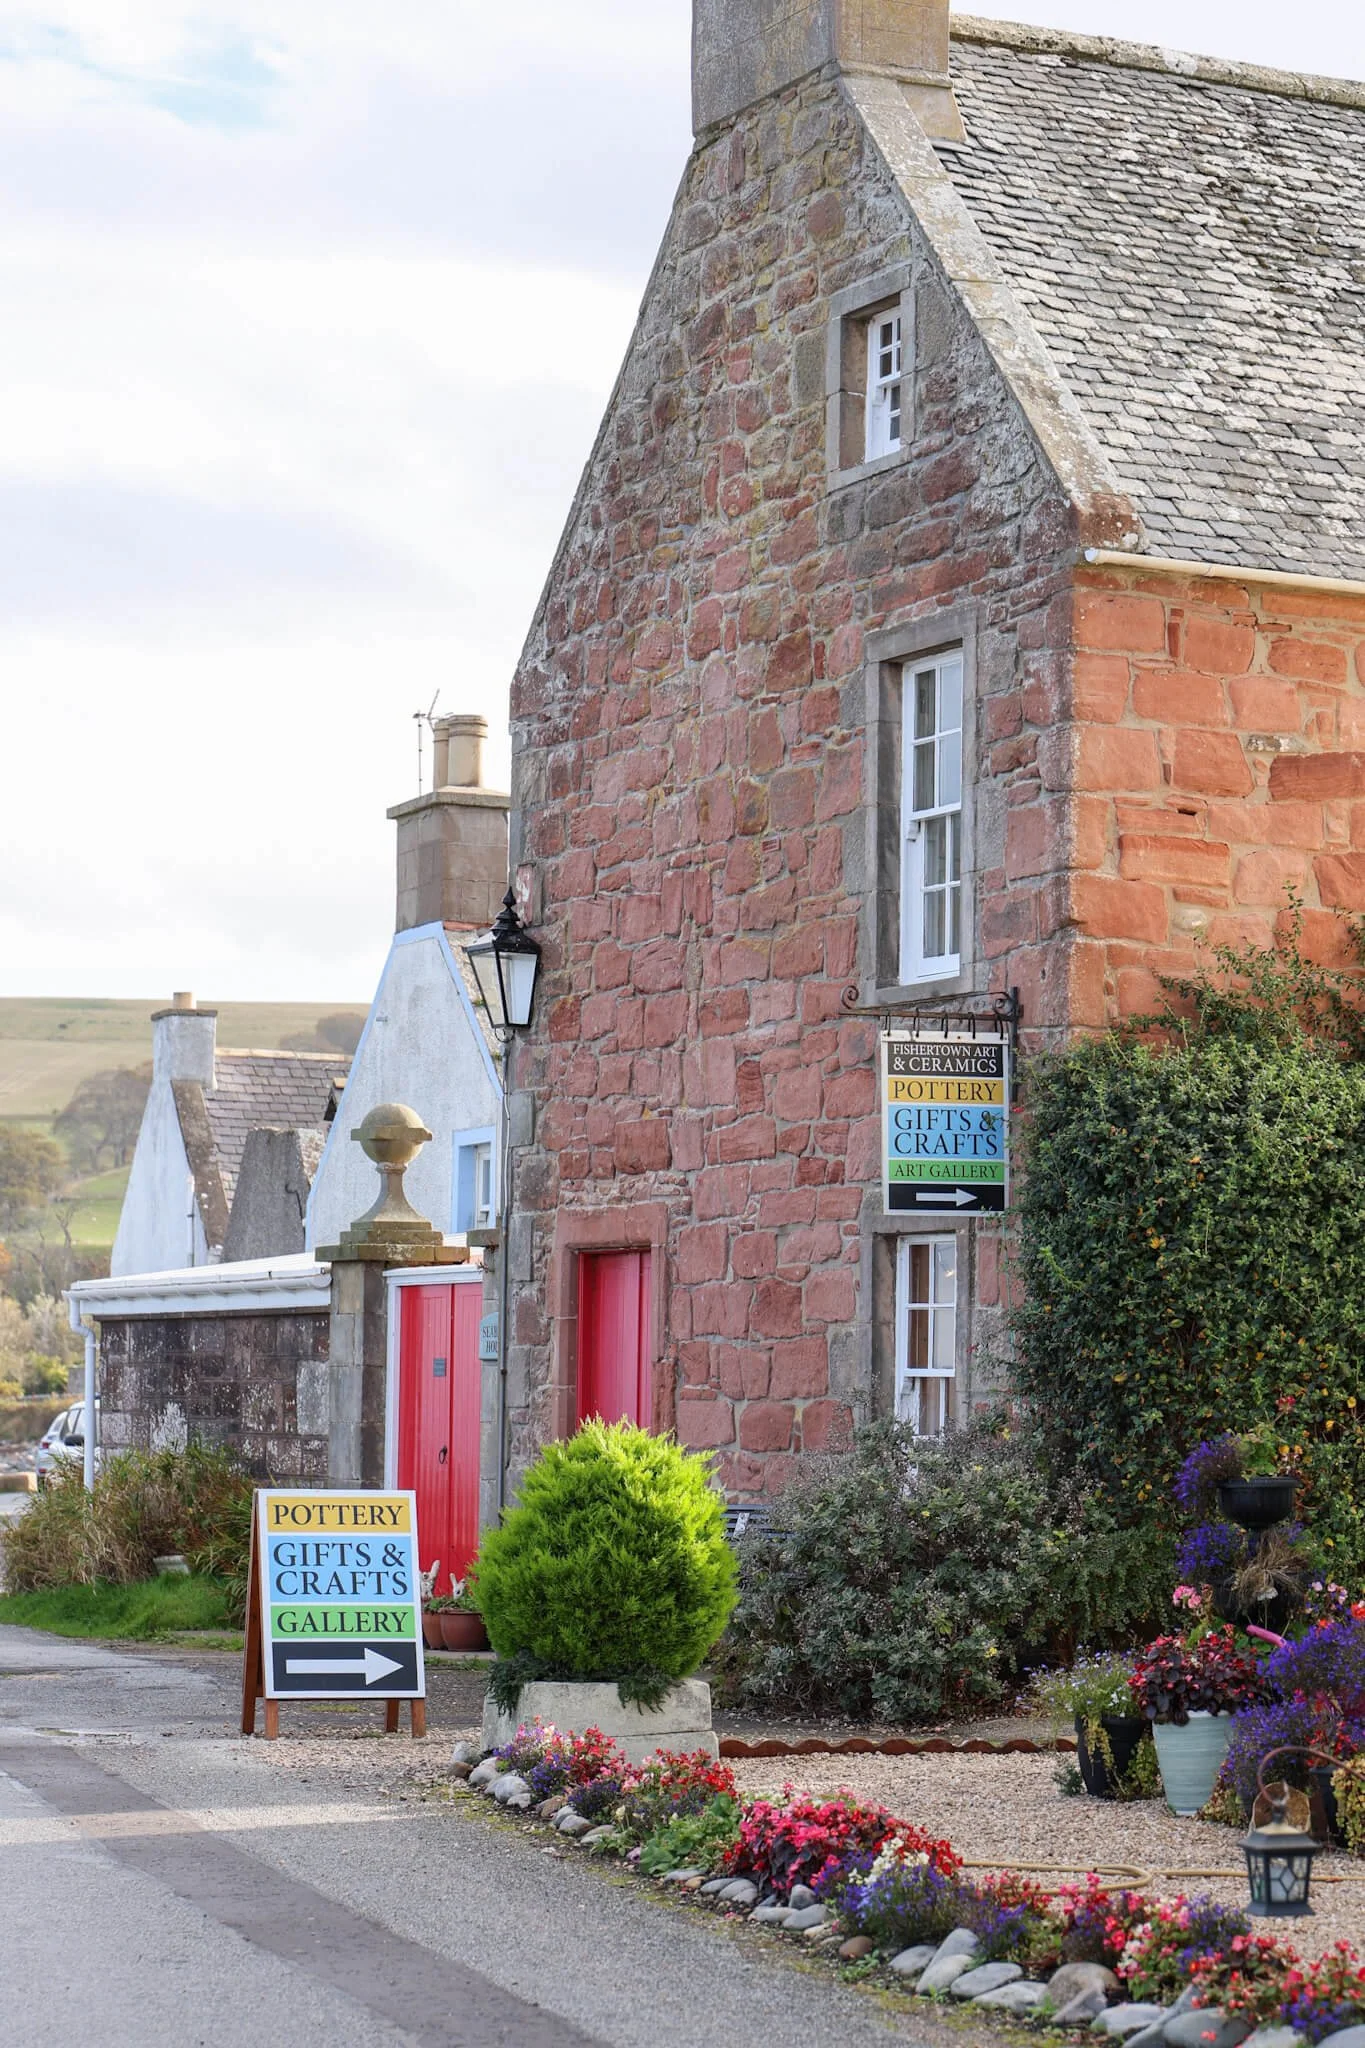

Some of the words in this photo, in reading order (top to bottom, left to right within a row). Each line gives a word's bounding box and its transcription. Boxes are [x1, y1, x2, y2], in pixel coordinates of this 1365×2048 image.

[893, 1043, 971, 1057] FISHERTOWN
[974, 1046, 998, 1058] ART
[893, 1056, 905, 1071] &
[908, 1057, 997, 1073] CERAMICS
[893, 1080, 998, 1101] POTTERY
[894, 1108, 971, 1132] GIFTS
[979, 1110, 998, 1132] &
[894, 1132, 998, 1156] CRAFTS
[894, 1163, 926, 1177] ART
[929, 1164, 999, 1179] GALLERY
[272, 1504, 404, 1526] POTTERY
[273, 1542, 372, 1567] GIFTS
[381, 1542, 406, 1567] &
[275, 1570, 408, 1596] CRAFTS
[276, 1610, 409, 1634] GALLERY
